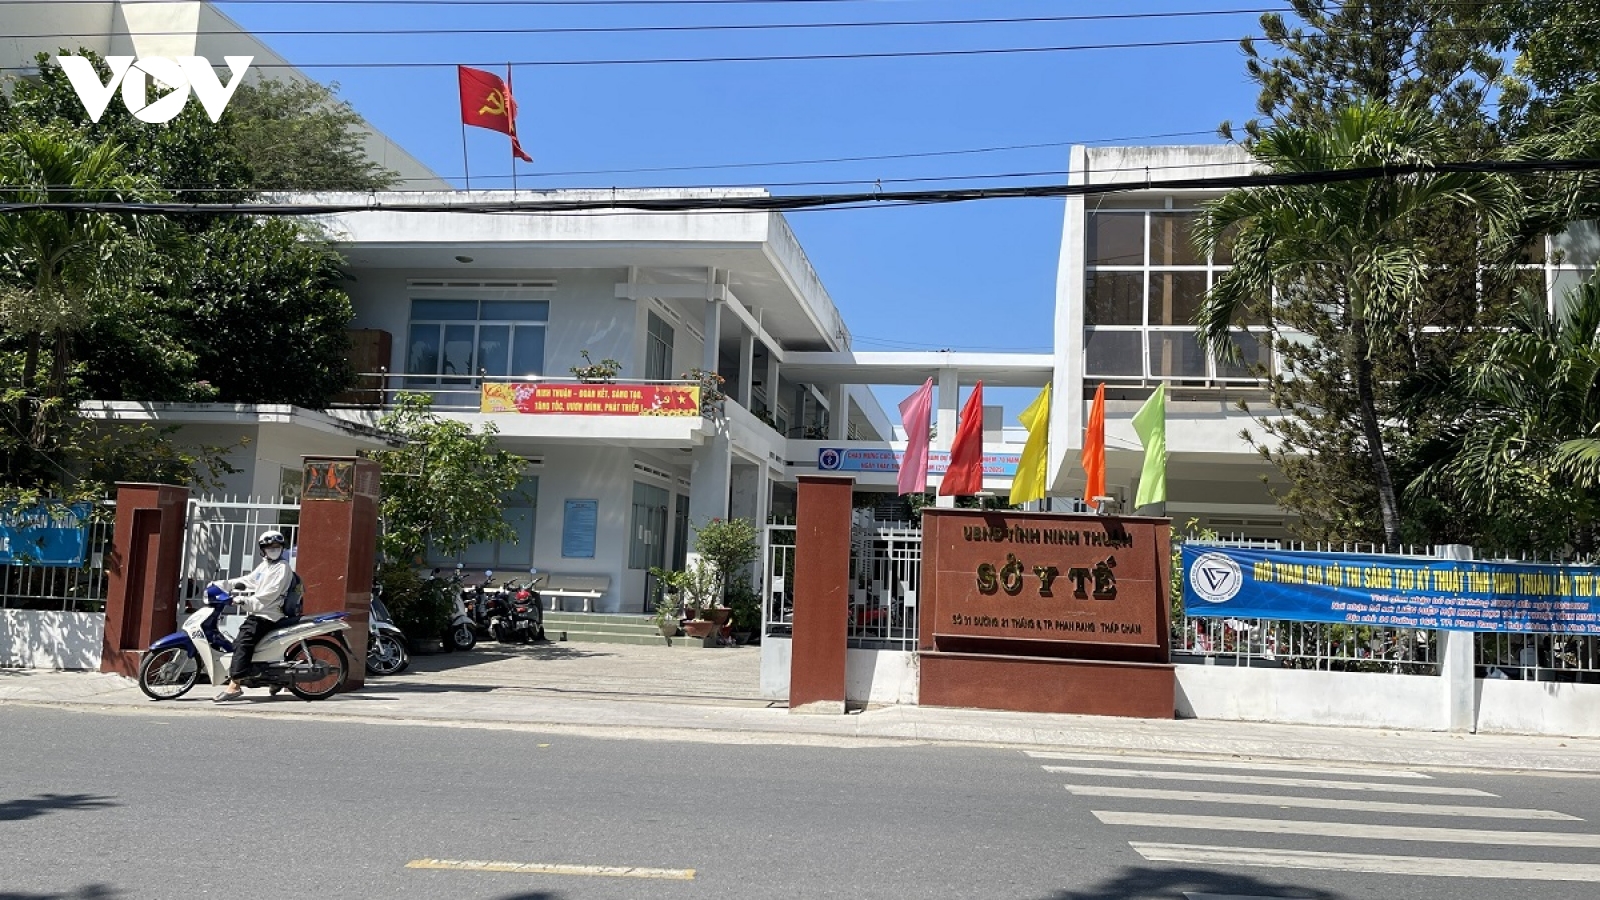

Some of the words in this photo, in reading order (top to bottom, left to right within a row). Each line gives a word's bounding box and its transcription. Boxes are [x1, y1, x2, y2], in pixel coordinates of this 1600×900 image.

[536, 388, 552, 397] NINH
[552, 387, 572, 399] THUẬN
[579, 387, 596, 398] ĐOÀN
[611, 388, 629, 399] SÁNG
[566, 402, 583, 411] VƯƠN
[604, 401, 620, 412] PHÁT
[621, 400, 640, 412] TRIỂN
[963, 525, 1003, 541] UBND
[1007, 523, 1041, 545] TỈNH
[1043, 527, 1080, 546] NINH
[1082, 529, 1134, 550] THUẬN
[976, 552, 1024, 597] SỞ
[1032, 565, 1060, 598] Y
[1067, 555, 1118, 600] TẾ
[1275, 562, 1304, 585] THAM
[1306, 564, 1323, 586] GIA
[1325, 561, 1342, 592] HỘI
[1345, 566, 1361, 588] THI
[1363, 563, 1393, 590] SÁNG
[1394, 568, 1414, 594] TẠO
[1416, 565, 1430, 591] KỸ
[1433, 566, 1466, 597] THUẬT
[1467, 565, 1490, 594] TỈNH
[1492, 571, 1517, 595] NINH
[1518, 569, 1550, 600] THUẬN
[1553, 567, 1572, 597] LẦN
[1574, 571, 1593, 597] THỨ
[952, 613, 962, 625] SỐ
[1001, 617, 1009, 629] 21
[1011, 616, 1034, 630] THÁNG
[1055, 619, 1074, 632] PHAN
[1076, 621, 1095, 633] RANG
[1100, 621, 1119, 634] THÁP
